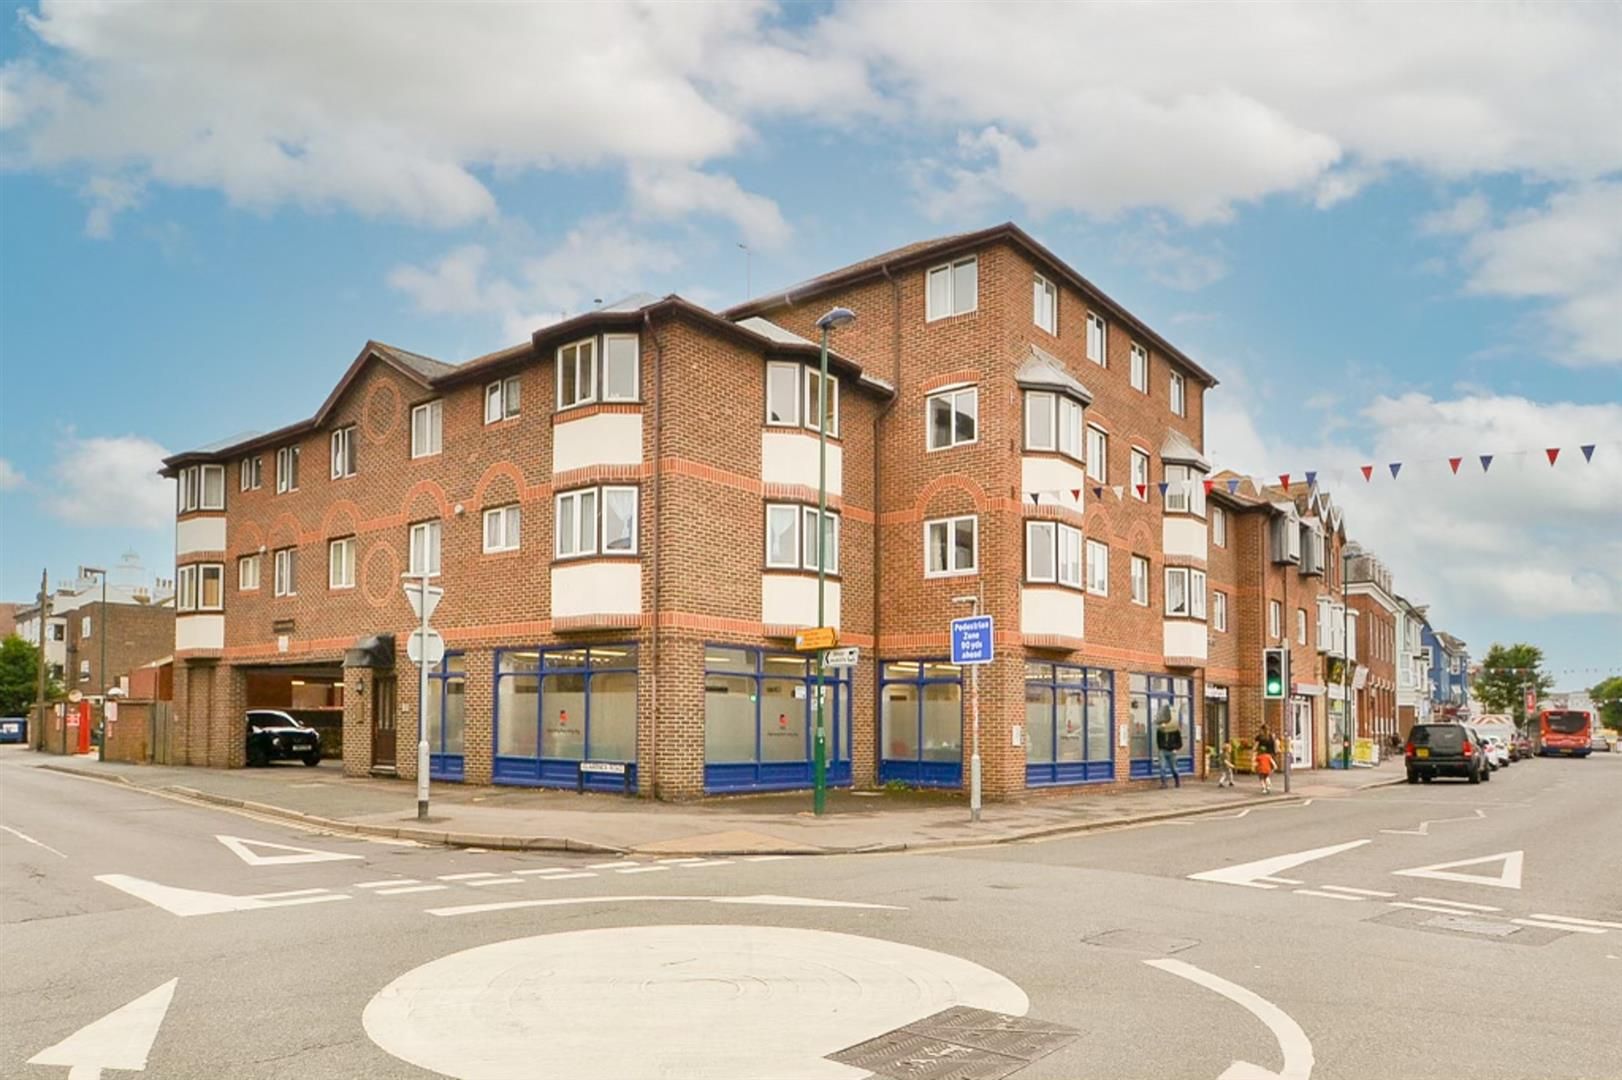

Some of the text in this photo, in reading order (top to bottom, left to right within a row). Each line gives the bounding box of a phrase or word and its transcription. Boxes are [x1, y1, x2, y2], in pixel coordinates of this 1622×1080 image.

[954, 621, 989, 632] Pedestrian
[963, 631, 980, 640] Zone
[961, 650, 982, 659] ahead
